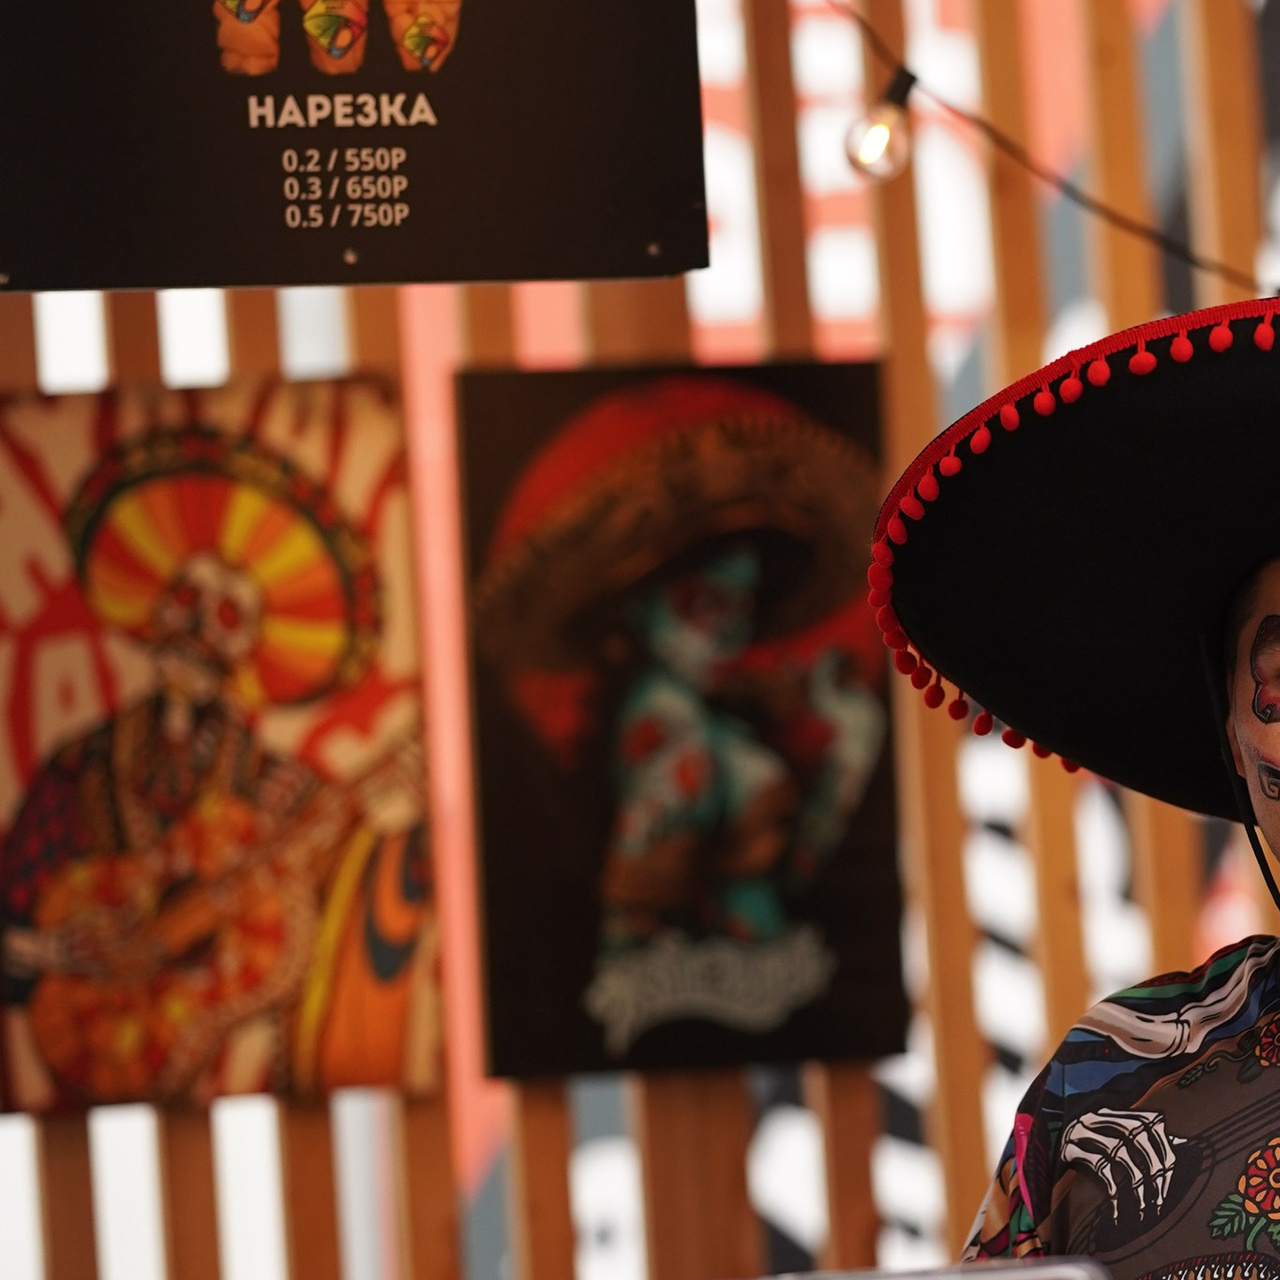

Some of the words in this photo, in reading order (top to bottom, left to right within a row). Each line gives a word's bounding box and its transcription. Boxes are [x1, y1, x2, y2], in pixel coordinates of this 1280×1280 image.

[248, 92, 438, 129] НАРЕЗКА
[282, 148, 322, 173] 0.2
[283, 176, 323, 201] 0.3
[285, 204, 324, 229] 0.5
